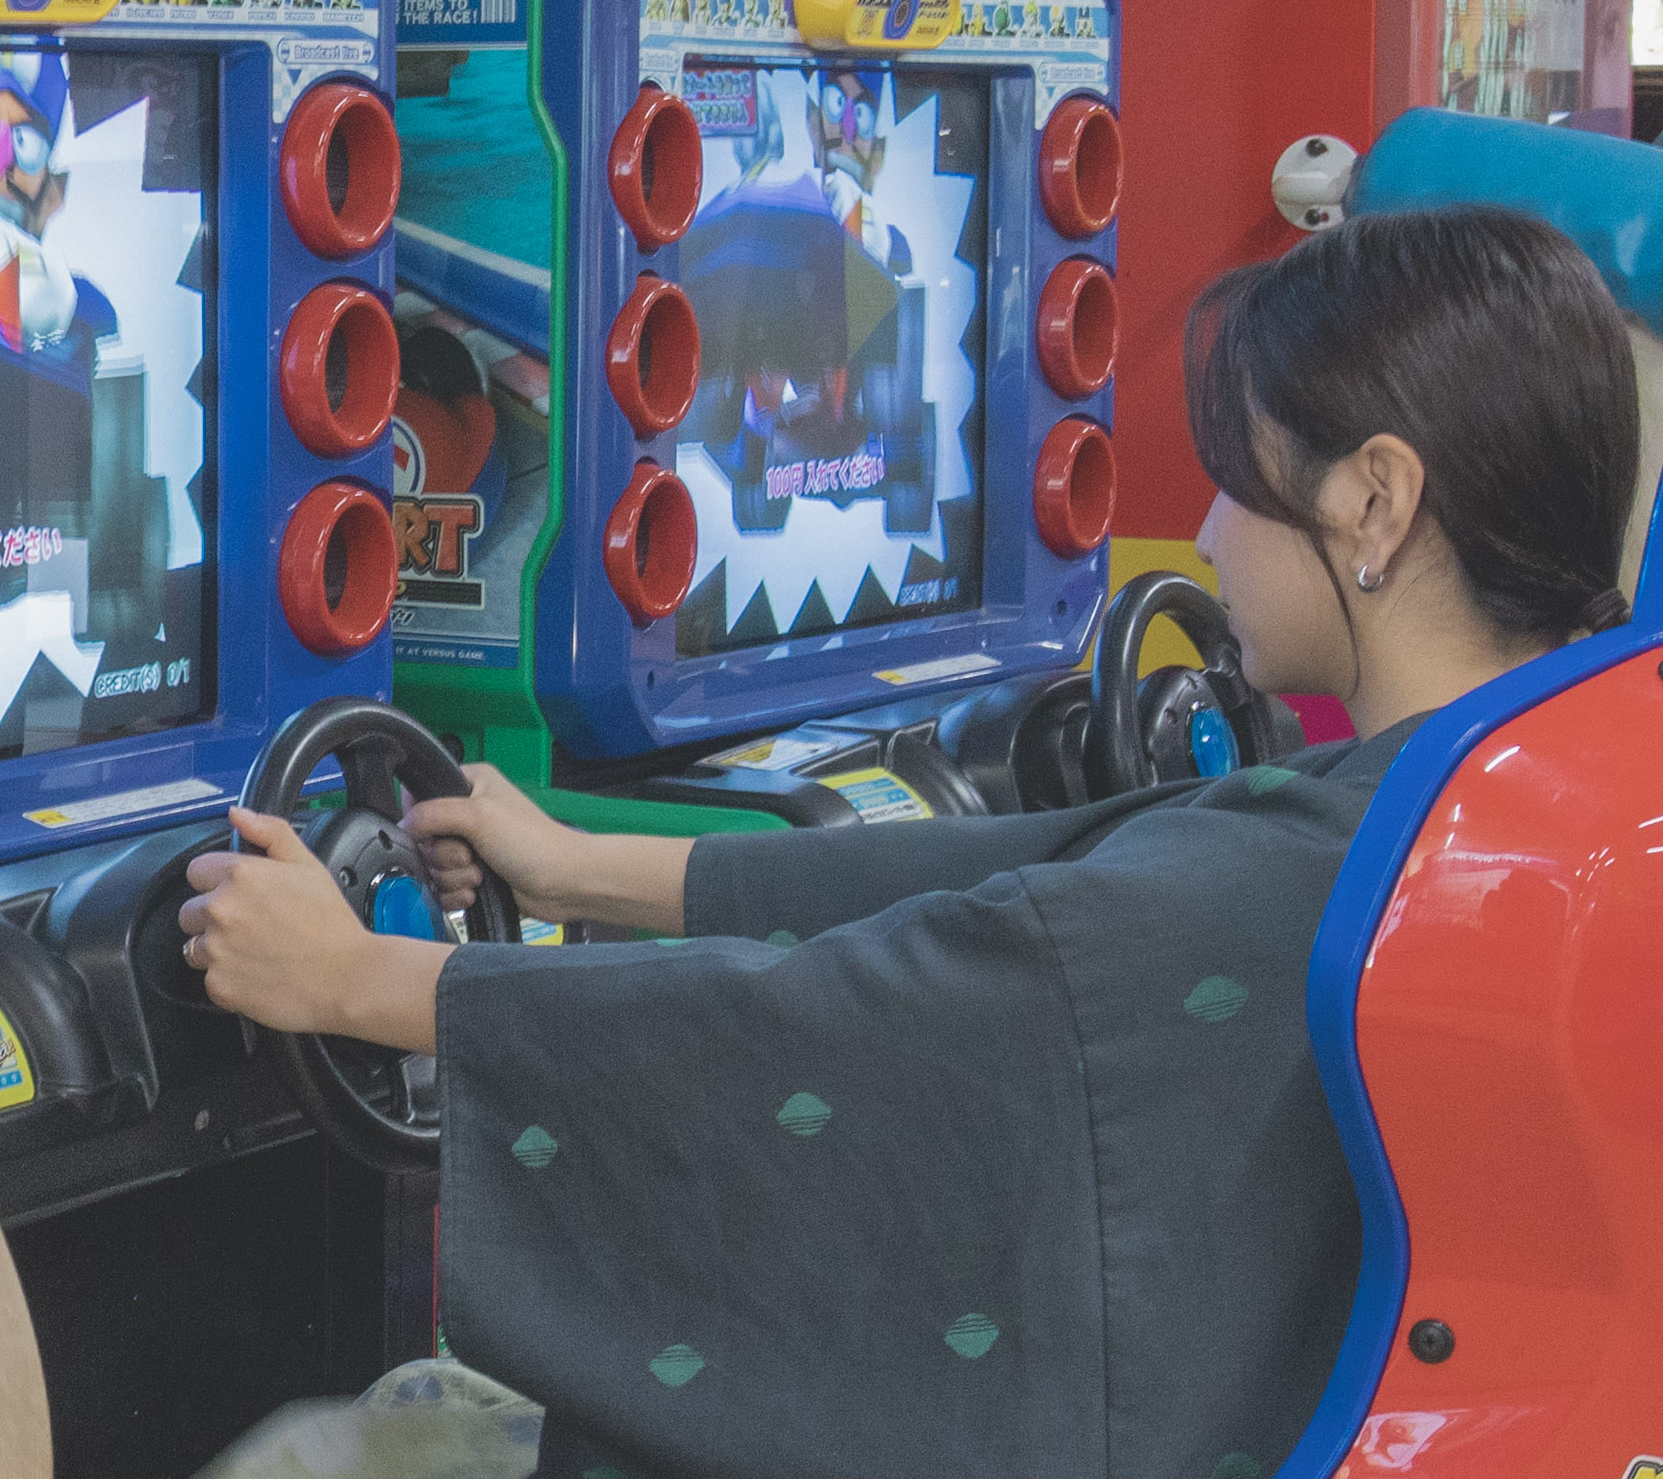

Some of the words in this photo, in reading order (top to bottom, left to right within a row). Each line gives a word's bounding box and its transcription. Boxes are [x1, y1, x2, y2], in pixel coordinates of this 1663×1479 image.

[404, 11, 430, 25] THE
[433, 9, 478, 25] RACE!
[293, 41, 341, 60] Broadcast
[342, 43, 360, 60] live
[421, 648, 456, 658] VERSUS
[93, 664, 161, 699] CREDIT(S)
